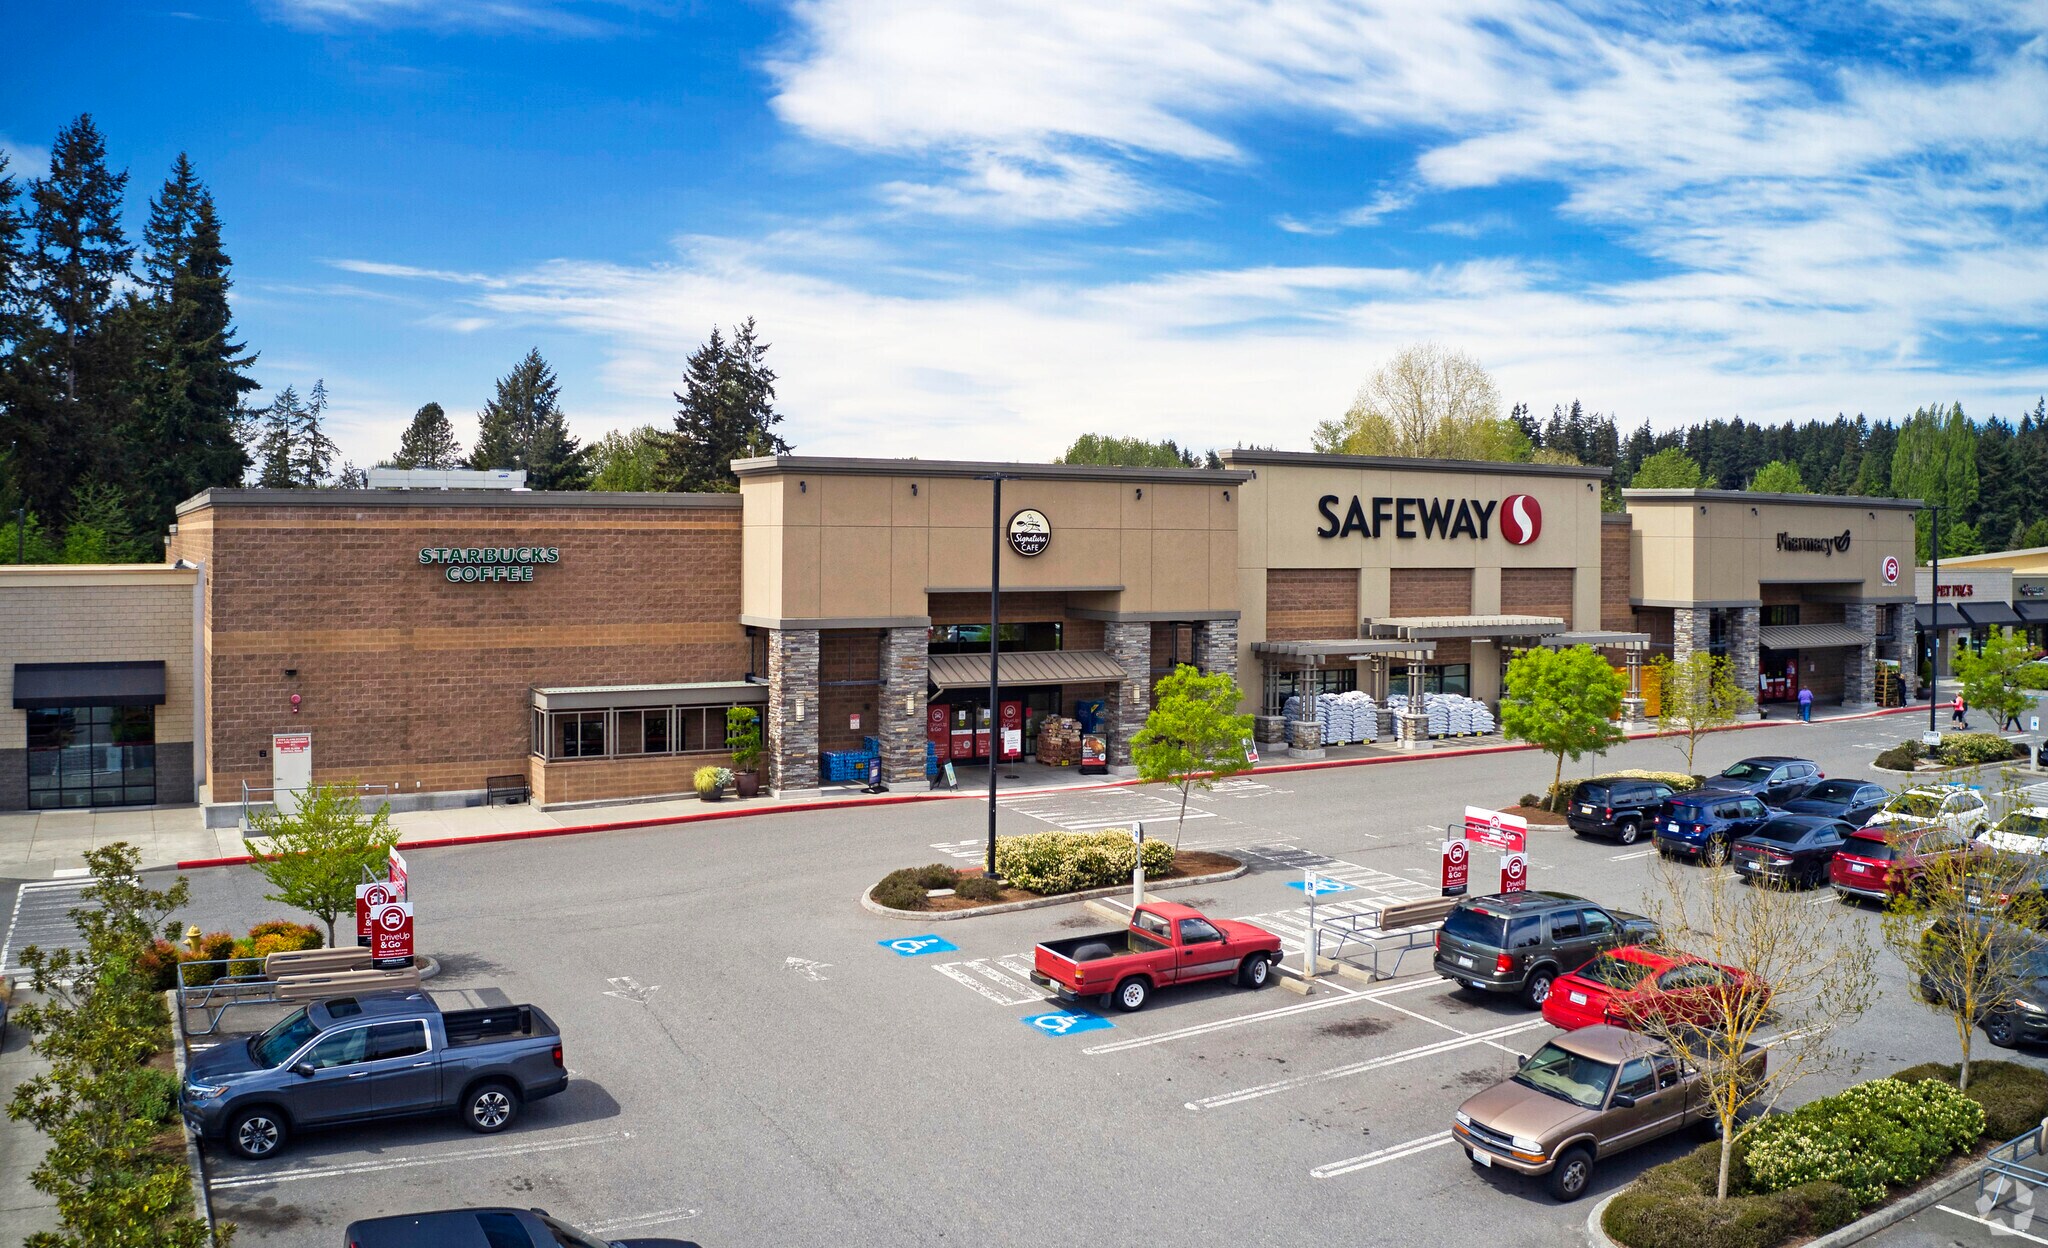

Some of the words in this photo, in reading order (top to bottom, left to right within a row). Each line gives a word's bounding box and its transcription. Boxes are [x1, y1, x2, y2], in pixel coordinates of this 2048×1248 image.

[1317, 494, 1498, 540] SAFEWAY
[1014, 533, 1046, 544] Signature
[1776, 531, 1834, 557] Pharmacy
[419, 547, 560, 564] STARBUCKS
[446, 565, 533, 583] COFFEE
[1936, 585, 1951, 597] PET
[380, 932, 410, 942] DriveUp
[387, 940, 401, 948] Go
